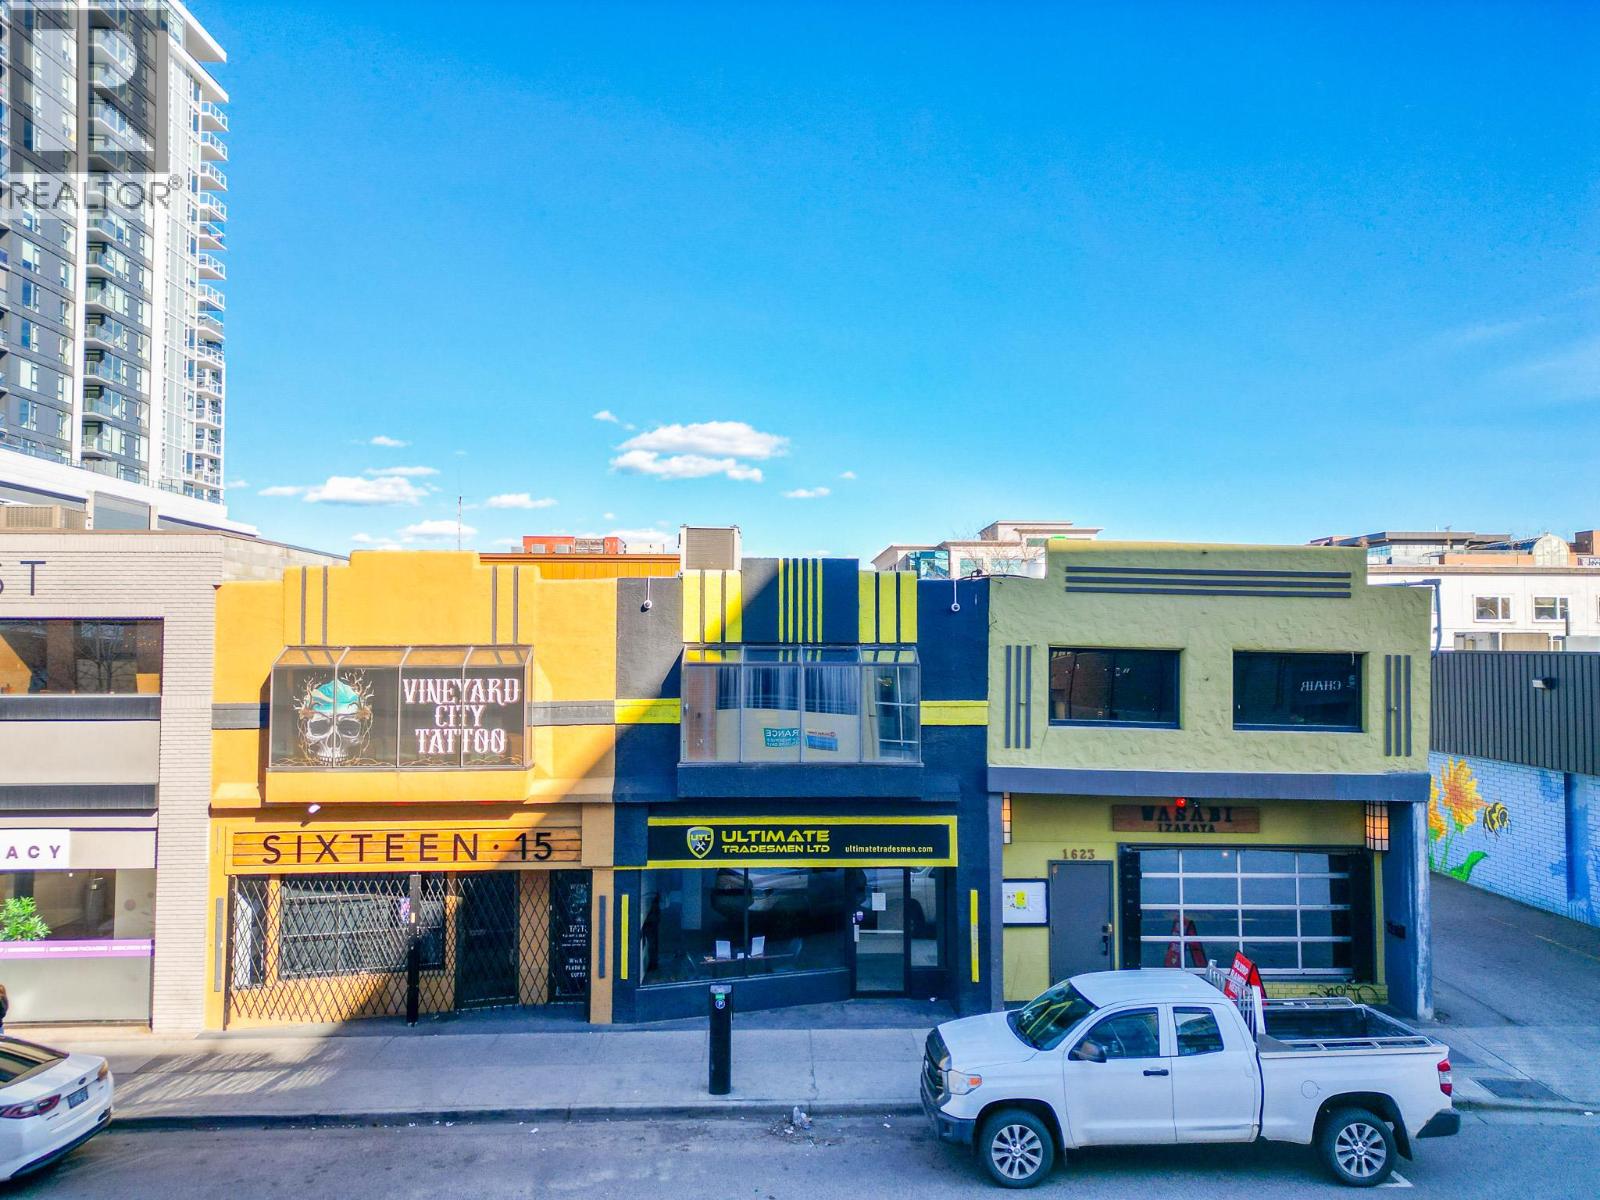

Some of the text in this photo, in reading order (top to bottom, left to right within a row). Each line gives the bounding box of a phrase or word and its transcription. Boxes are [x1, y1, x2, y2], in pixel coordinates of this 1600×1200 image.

[0, 560, 47, 596] T
[403, 678, 520, 706] VINEYARD
[435, 704, 485, 727] CITY
[415, 728, 507, 754] TATTOO
[721, 829, 830, 842] ULTIMATE
[6, 845, 61, 859] ACY
[262, 832, 552, 864] SIXTEEN 15
[721, 845, 831, 853] TRADESMEN LTD
[845, 844, 933, 853] ultimatetradesmen.com
[1062, 848, 1096, 860] 1623
